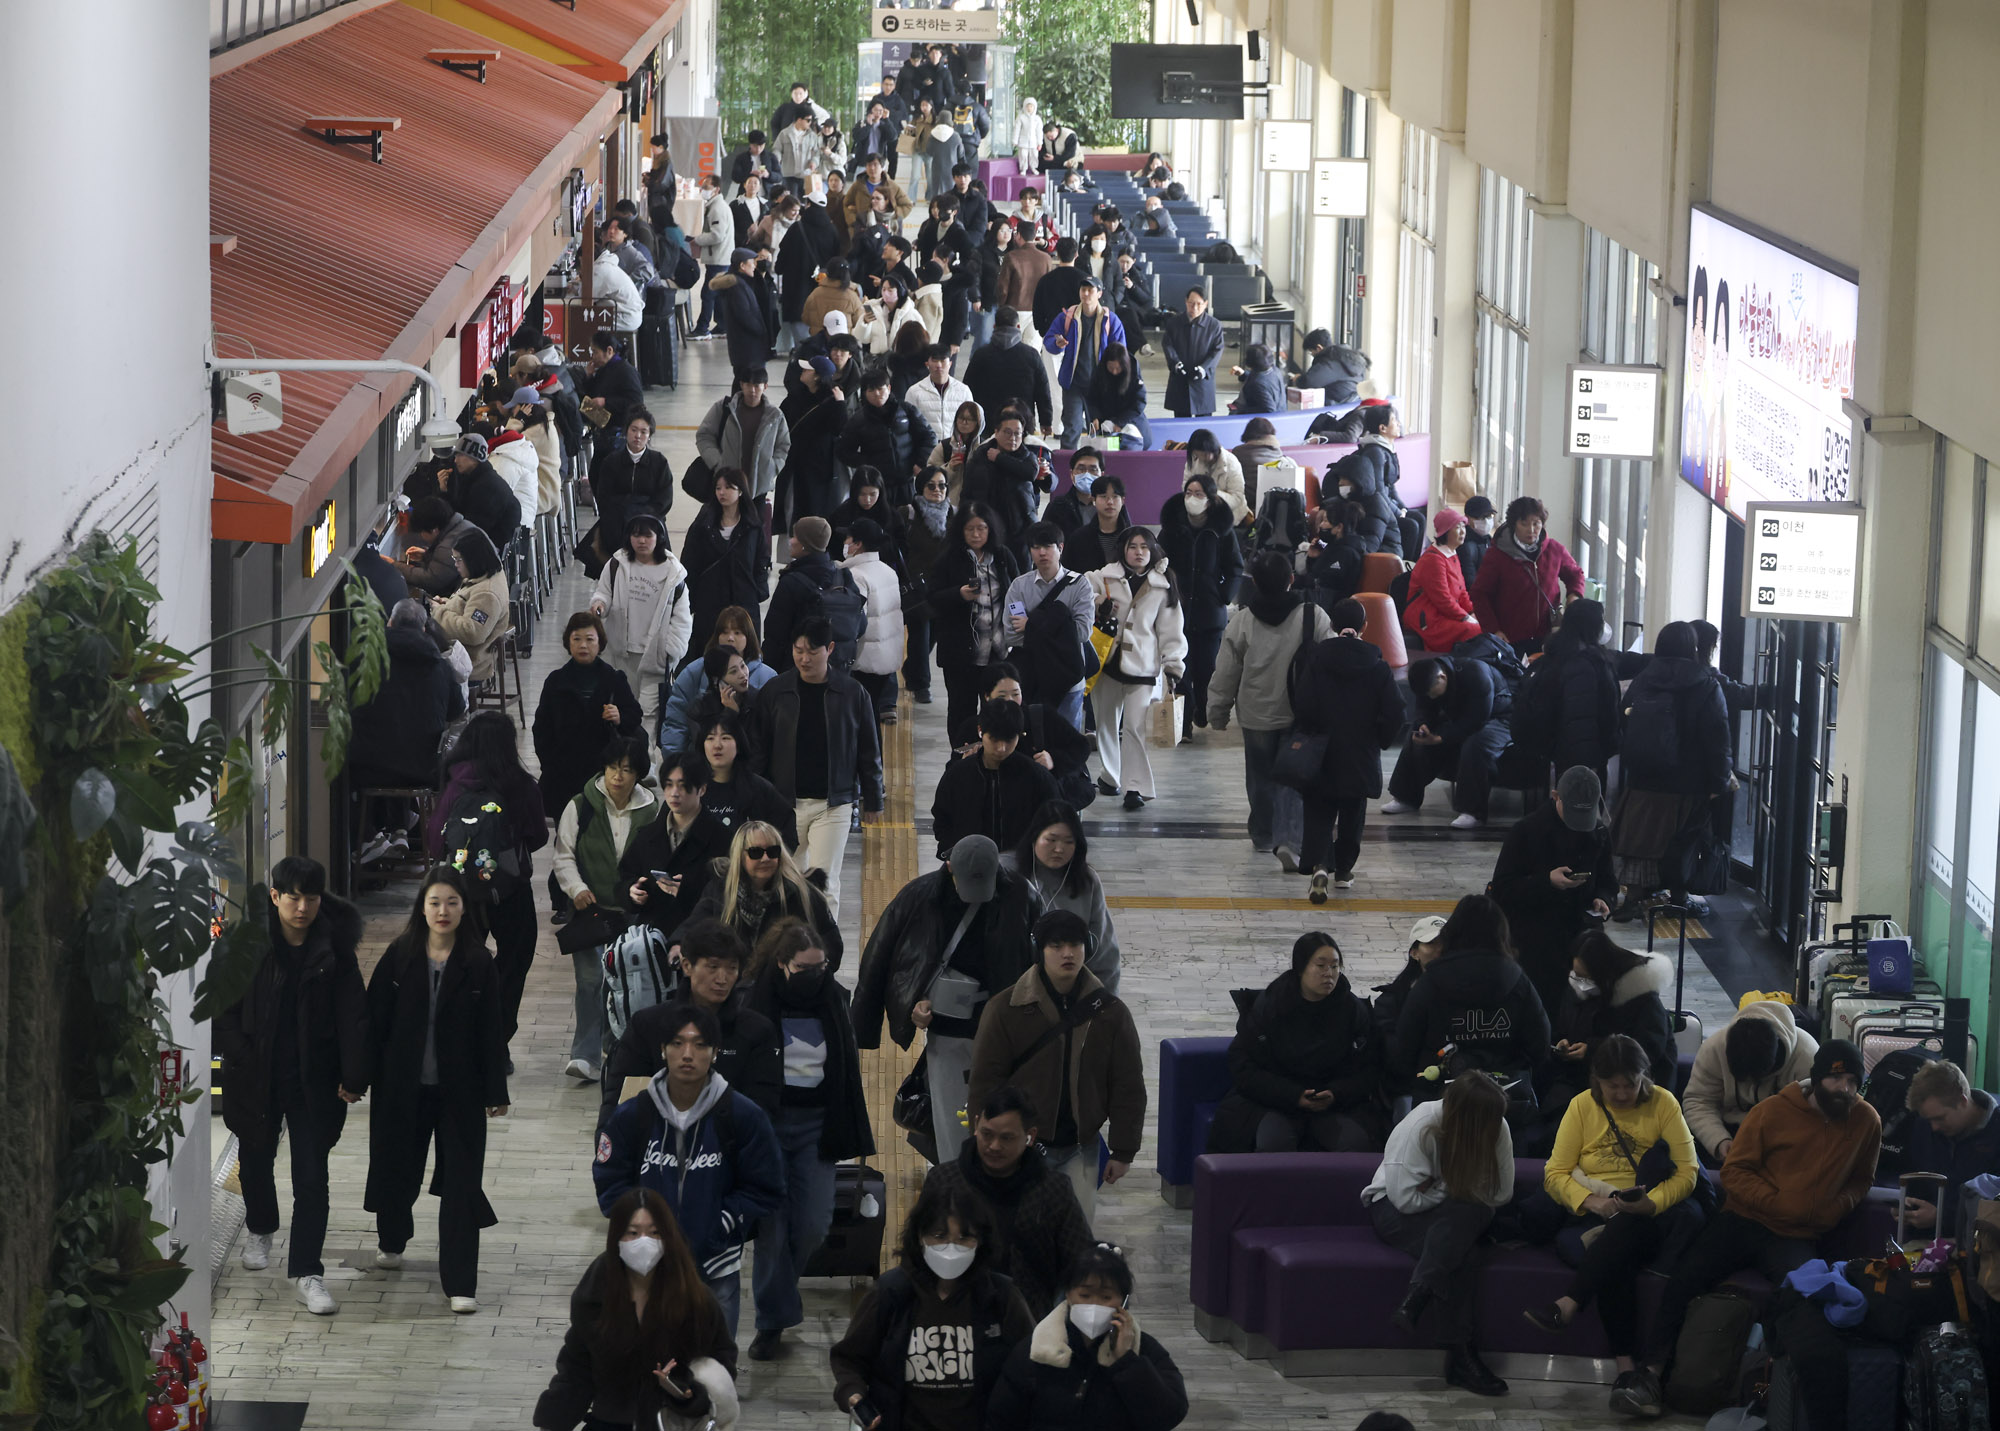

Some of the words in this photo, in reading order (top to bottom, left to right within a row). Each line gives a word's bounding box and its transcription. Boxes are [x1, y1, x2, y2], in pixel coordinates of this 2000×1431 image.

[903, 18, 952, 32] 도착하는
[955, 19, 967, 32] 곳
[1580, 380, 1592, 391] 31
[1578, 407, 1590, 418] 31
[1577, 435, 1589, 446] 32
[1763, 522, 1778, 534] 28
[1783, 521, 1804, 533] 이천
[1760, 556, 1776, 568] 29
[1759, 590, 1774, 602] 30
[1482, 1031, 1511, 1039] ITALIA
